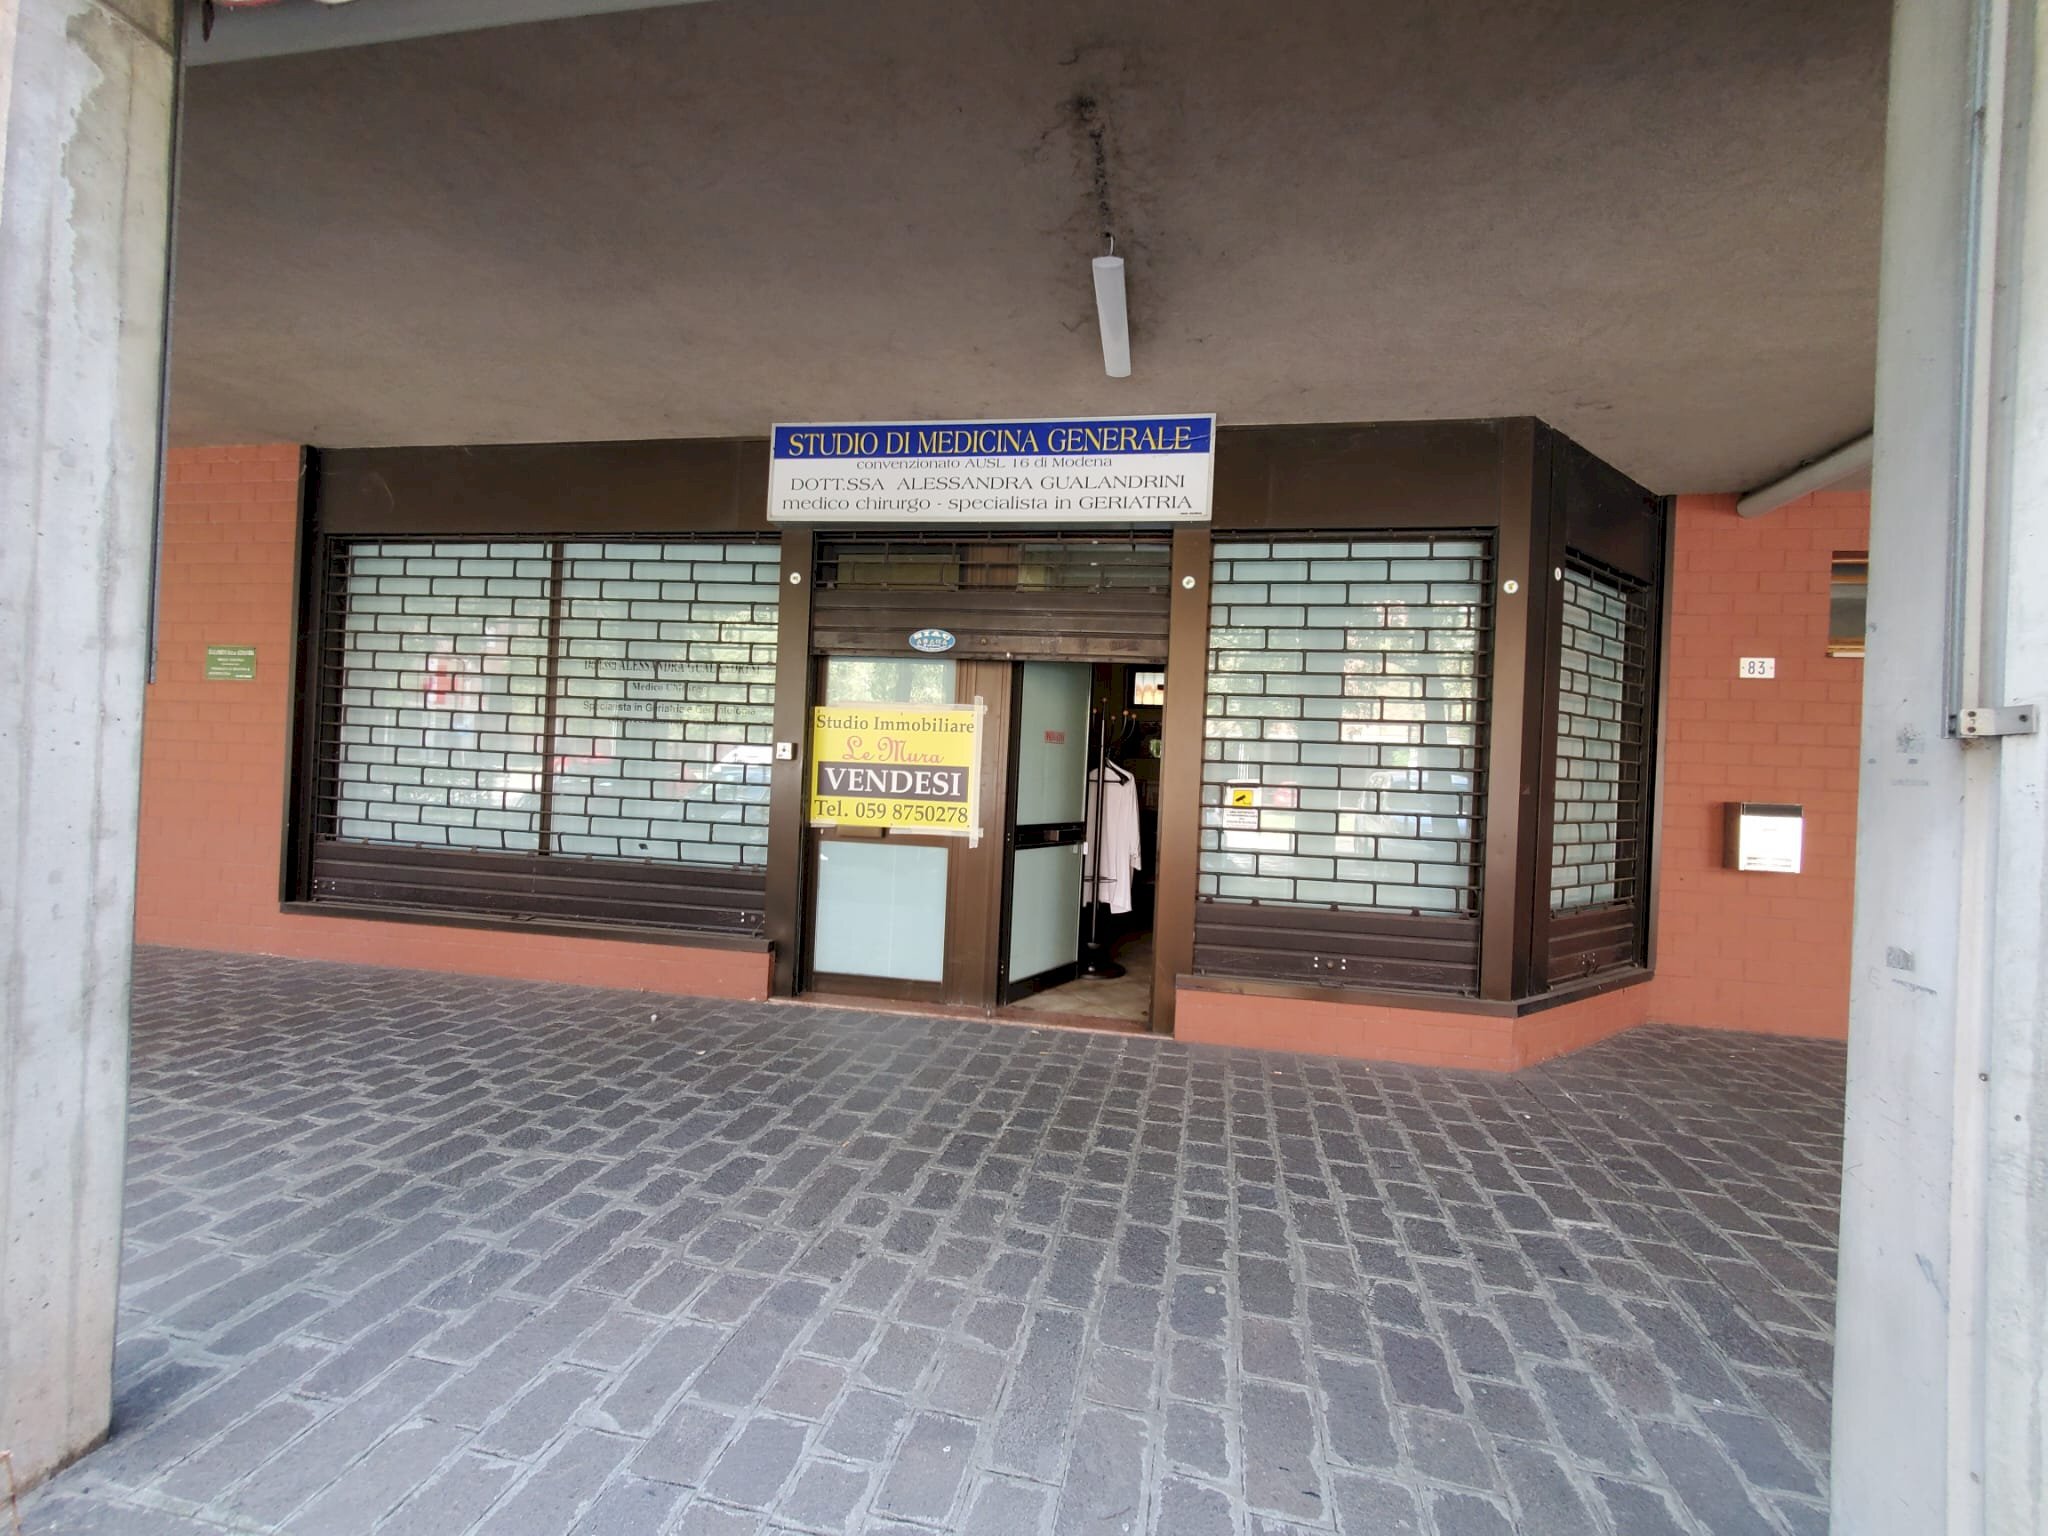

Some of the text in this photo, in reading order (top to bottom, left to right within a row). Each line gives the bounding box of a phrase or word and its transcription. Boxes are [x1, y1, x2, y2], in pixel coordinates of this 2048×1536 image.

[788, 426, 1192, 456] STUDIO DI MEDICINA GENERALE
[856, 456, 1112, 470] convenzionato AUSL 16 di Modena
[791, 474, 1185, 491] DOTT.SSA ALESSANDRA GUALANDRINI
[782, 496, 850, 510] medico
[855, 496, 931, 513] chirurgo
[948, 495, 1048, 513] specialista
[1055, 495, 1072, 510] in
[1079, 495, 1192, 510] GERIATRIA
[1747, 660, 1765, 675] 83
[816, 714, 975, 734] Studio Immobiliare
[842, 735, 945, 764] Le Mura
[824, 767, 962, 797] VENDESI
[814, 799, 968, 824] Tel. 059 8750278
